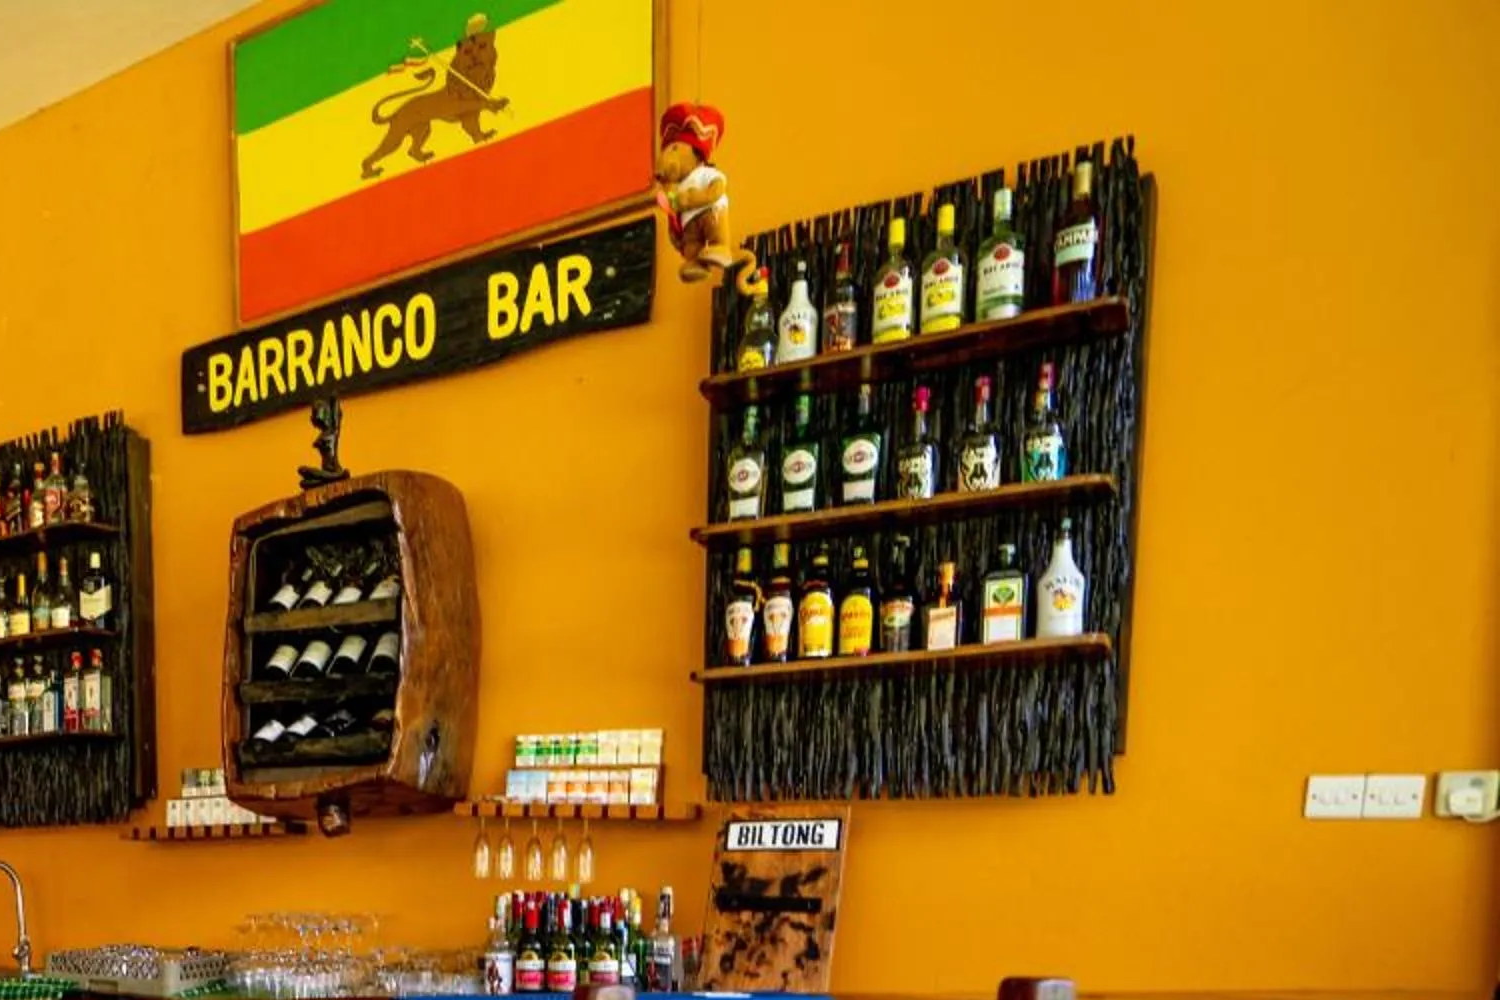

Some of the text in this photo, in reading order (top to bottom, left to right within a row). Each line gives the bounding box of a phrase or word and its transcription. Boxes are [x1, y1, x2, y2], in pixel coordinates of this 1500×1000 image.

[1055, 227, 1099, 251] AMPA
[207, 254, 593, 413] BARRANCO BAR
[737, 822, 825, 846] BILTONG
